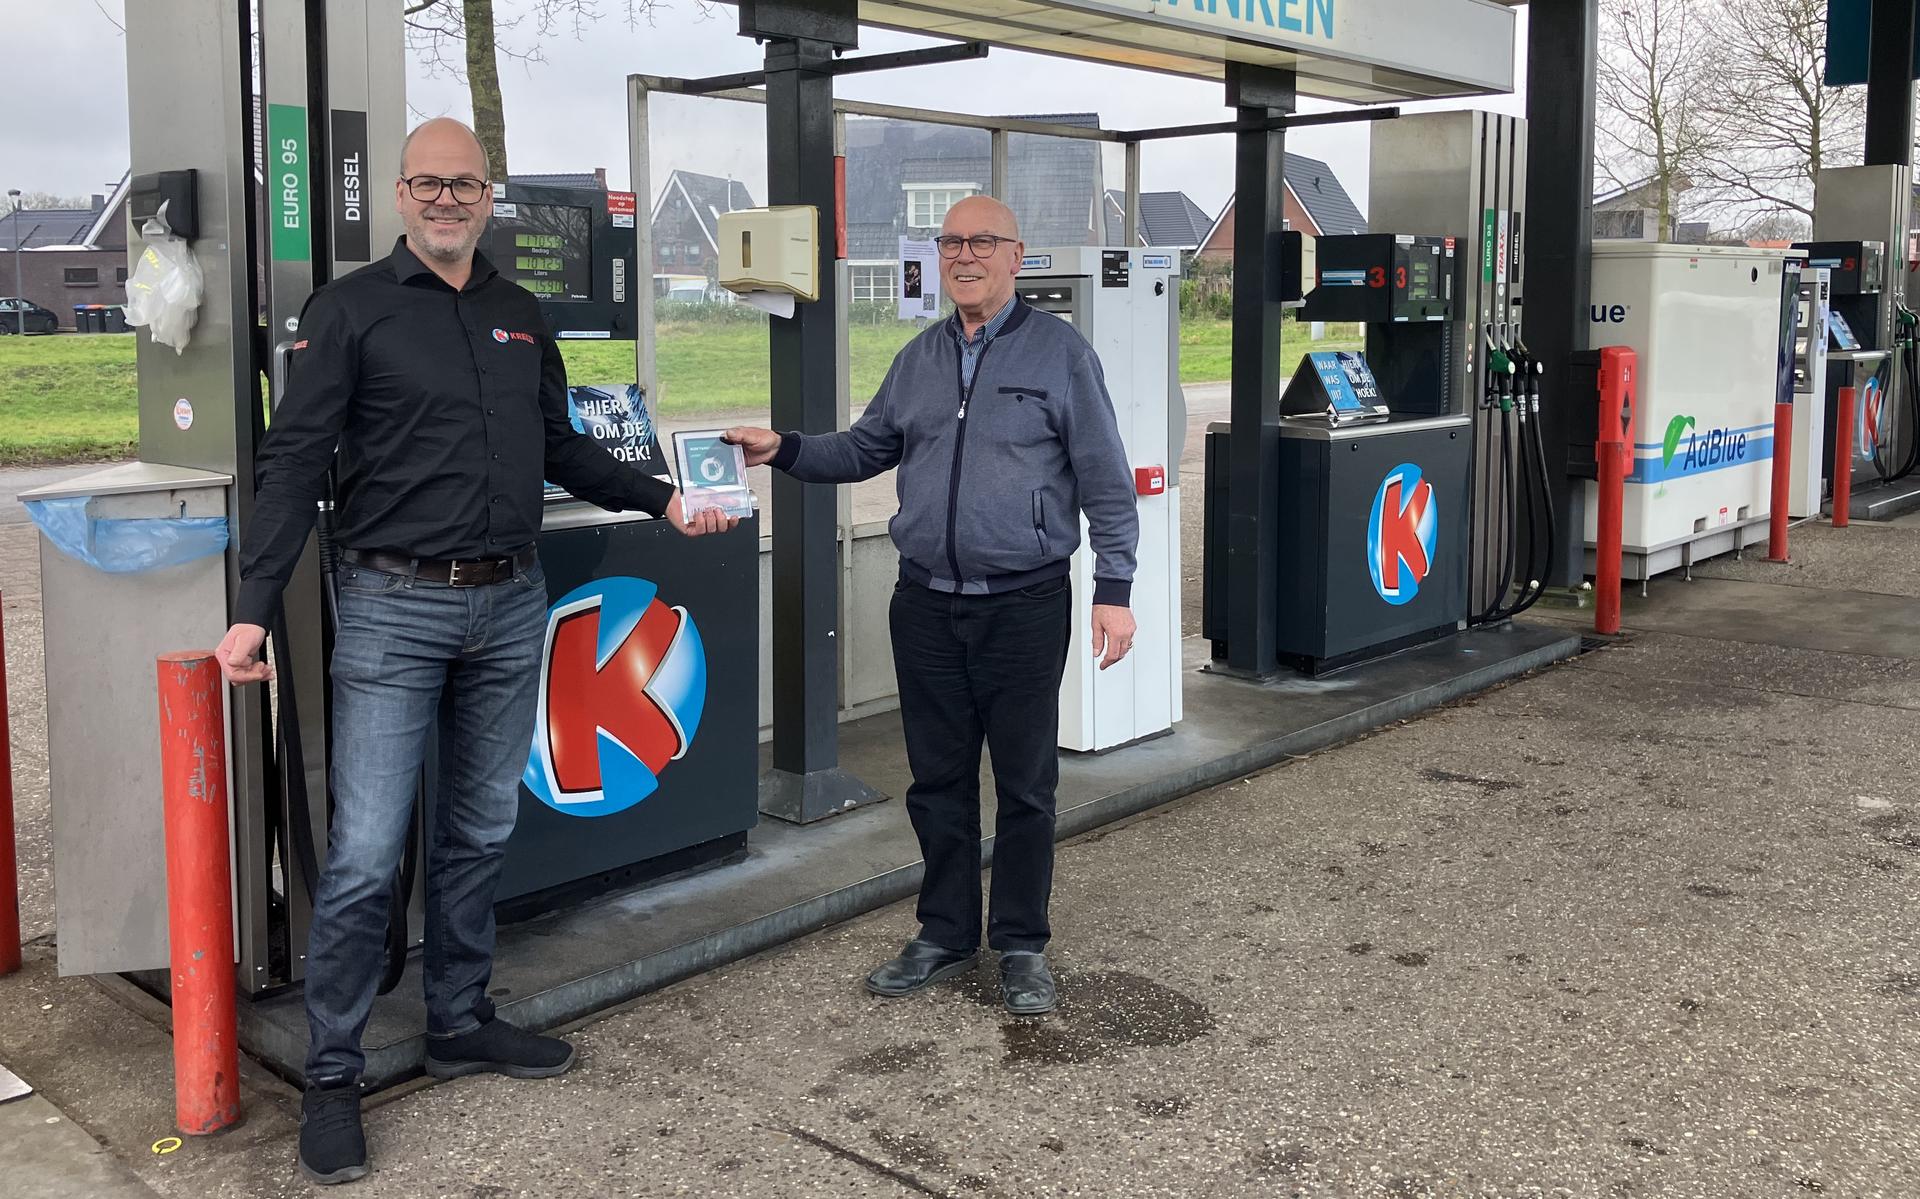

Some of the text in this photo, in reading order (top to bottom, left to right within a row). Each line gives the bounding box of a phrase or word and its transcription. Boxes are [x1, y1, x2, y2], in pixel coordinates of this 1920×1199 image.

[282, 139, 299, 229] EURO 95
[344, 152, 360, 221] DIESEL
[608, 194, 634, 203] Noodstop
[1486, 224, 1492, 237] 95
[1368, 266, 1386, 289] 3
[1396, 266, 1407, 289] 3
[1317, 360, 1337, 370] WAAR
[1341, 360, 1361, 369] HIER
[1324, 375, 1340, 385] WAS
[1349, 373, 1371, 384] OM DE
[1355, 388, 1377, 398] HOEK!
[583, 399, 622, 416] HIER
[592, 421, 645, 439] OM DE
[607, 445, 651, 463] OEK!
[1683, 427, 1746, 471] AdBlue
[1376, 472, 1433, 597] K
[536, 593, 689, 804] K
